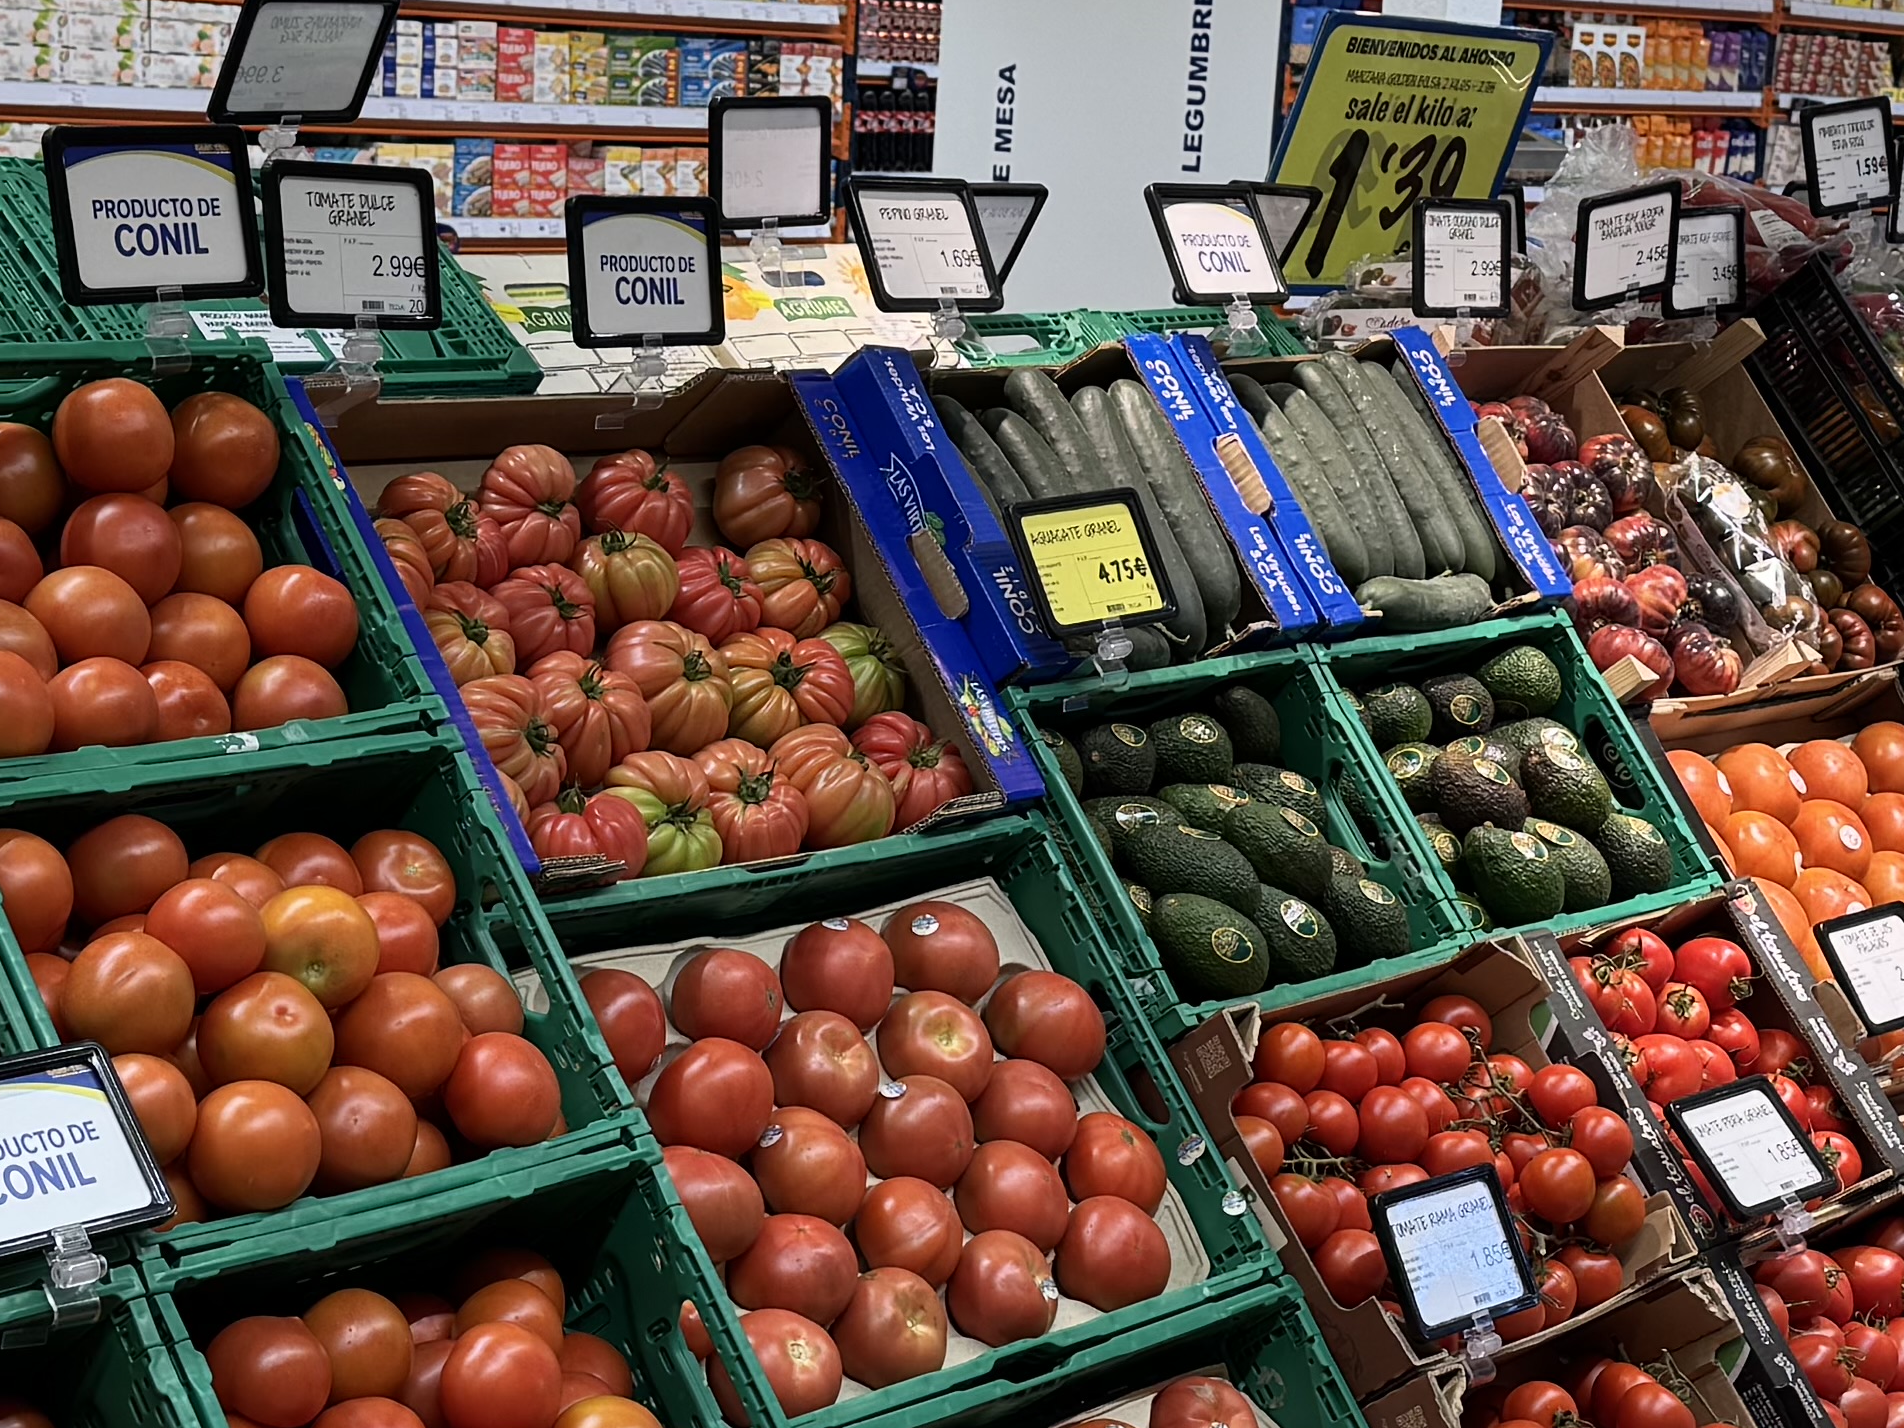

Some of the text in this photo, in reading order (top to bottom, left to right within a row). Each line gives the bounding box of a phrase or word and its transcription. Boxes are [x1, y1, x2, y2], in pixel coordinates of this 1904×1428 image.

[1346, 37, 1515, 66] BIENVENIDOS AL AHORRO
[1346, 69, 1386, 84] MANZANA
[994, 64, 1017, 152] MESA
[1345, 92, 1477, 128] sale el kilo a:
[92, 198, 221, 219] PRODUCTO DE
[305, 191, 395, 211] TOMATE DULCE
[329, 210, 375, 226] GRANEL
[115, 223, 209, 257] CONIL
[1181, 234, 1252, 248] PRODUCTO DE
[600, 255, 695, 273] PRODUCTO DE
[940, 249, 980, 268] 1.69€
[1198, 251, 1251, 273] CONIL
[1637, 244, 1669, 266] 2.45€
[372, 255, 425, 278] 2.99€
[615, 276, 685, 305] CONIL
[409, 300, 424, 313] 20
[779, 298, 850, 316] AGRUMES
[1031, 520, 1121, 546] AGUACATE GRANEL
[1099, 557, 1147, 584] 4.75€
[67, 1120, 99, 1144] DE
[1768, 1139, 1804, 1163] 1.85€
[1471, 1241, 1512, 1269] 1.85€
